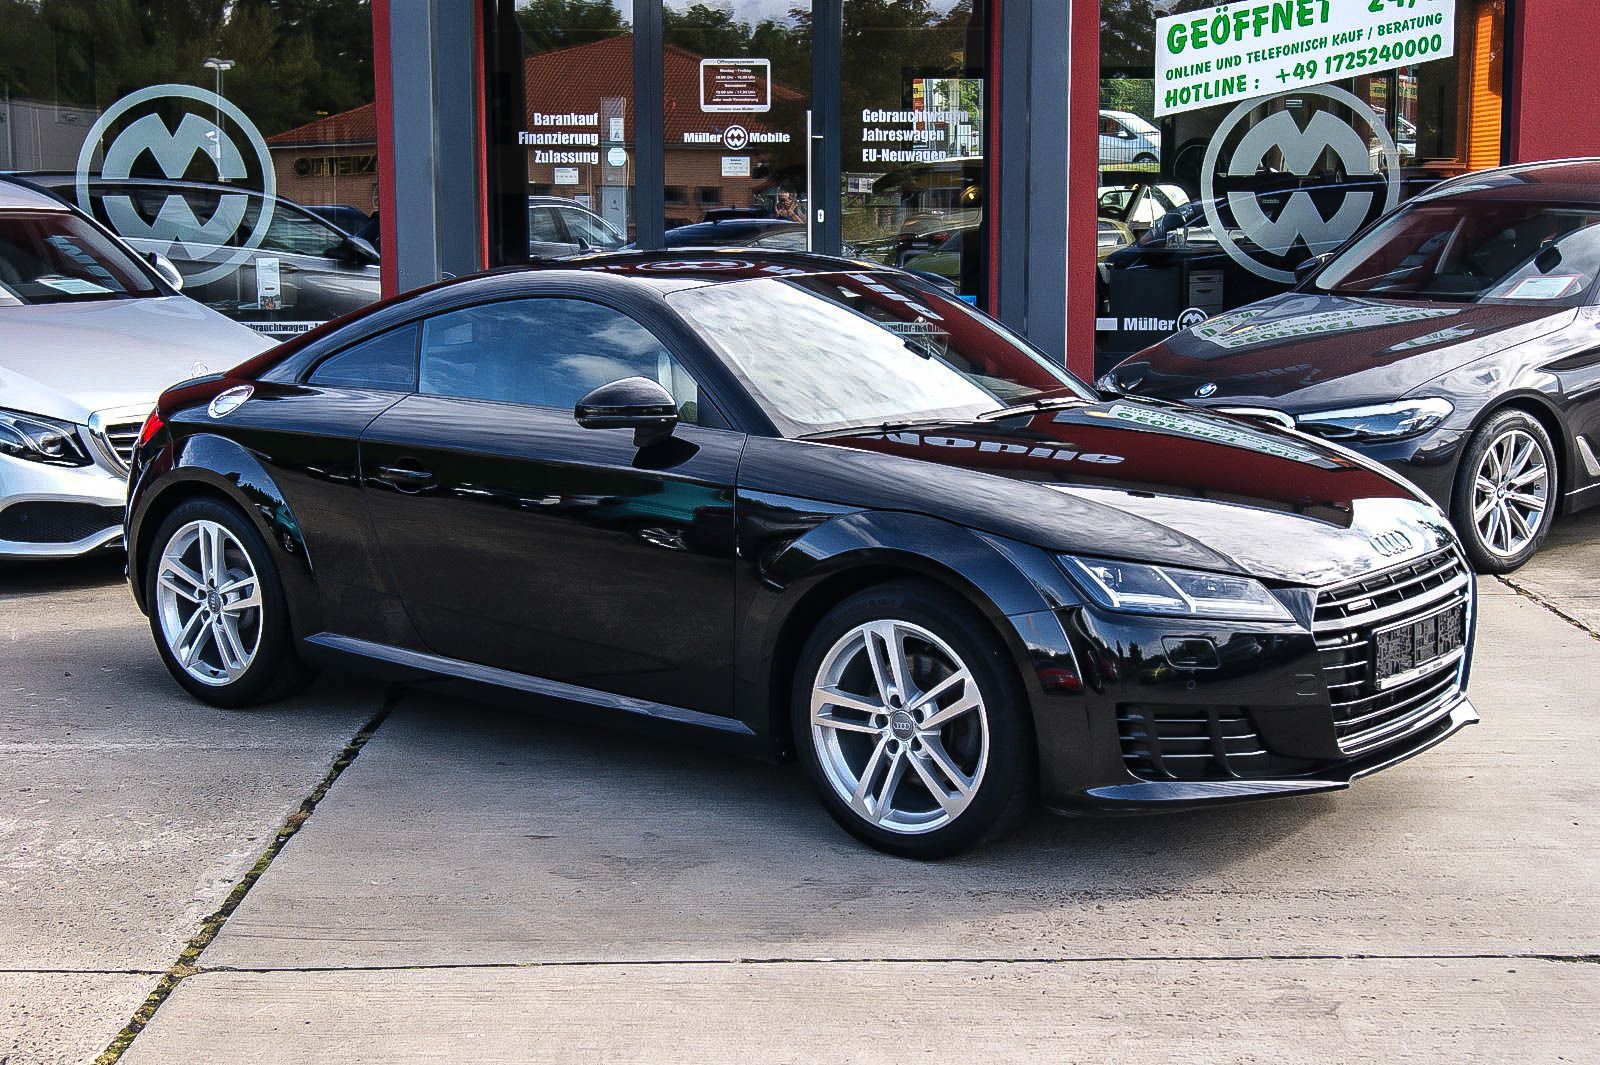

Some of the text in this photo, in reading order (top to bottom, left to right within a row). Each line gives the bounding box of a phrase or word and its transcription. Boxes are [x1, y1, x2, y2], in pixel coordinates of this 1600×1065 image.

[1166, 0, 1330, 55] GEÖFFNET
[1165, 62, 1212, 81] ONLINE
[1215, 55, 1242, 71] UND
[1246, 37, 1328, 65] TELEFONISCH
[1331, 28, 1364, 55] KAUF
[1377, 13, 1443, 37] BERATUNG
[1164, 75, 1247, 109] HOTLINE
[1275, 60, 1318, 85] +49
[1324, 35, 1442, 76] 1725240000
[533, 112, 599, 126] Barankauf
[862, 109, 968, 123] Gebrauchtwagen
[518, 131, 599, 147] Finanzierung
[683, 131, 791, 143] Müller Mobile
[862, 127, 945, 143] Jahreswagen
[534, 149, 599, 165] Zulassung
[862, 148, 947, 163] EU-Neuwagen
[1122, 317, 1176, 331] Müller
